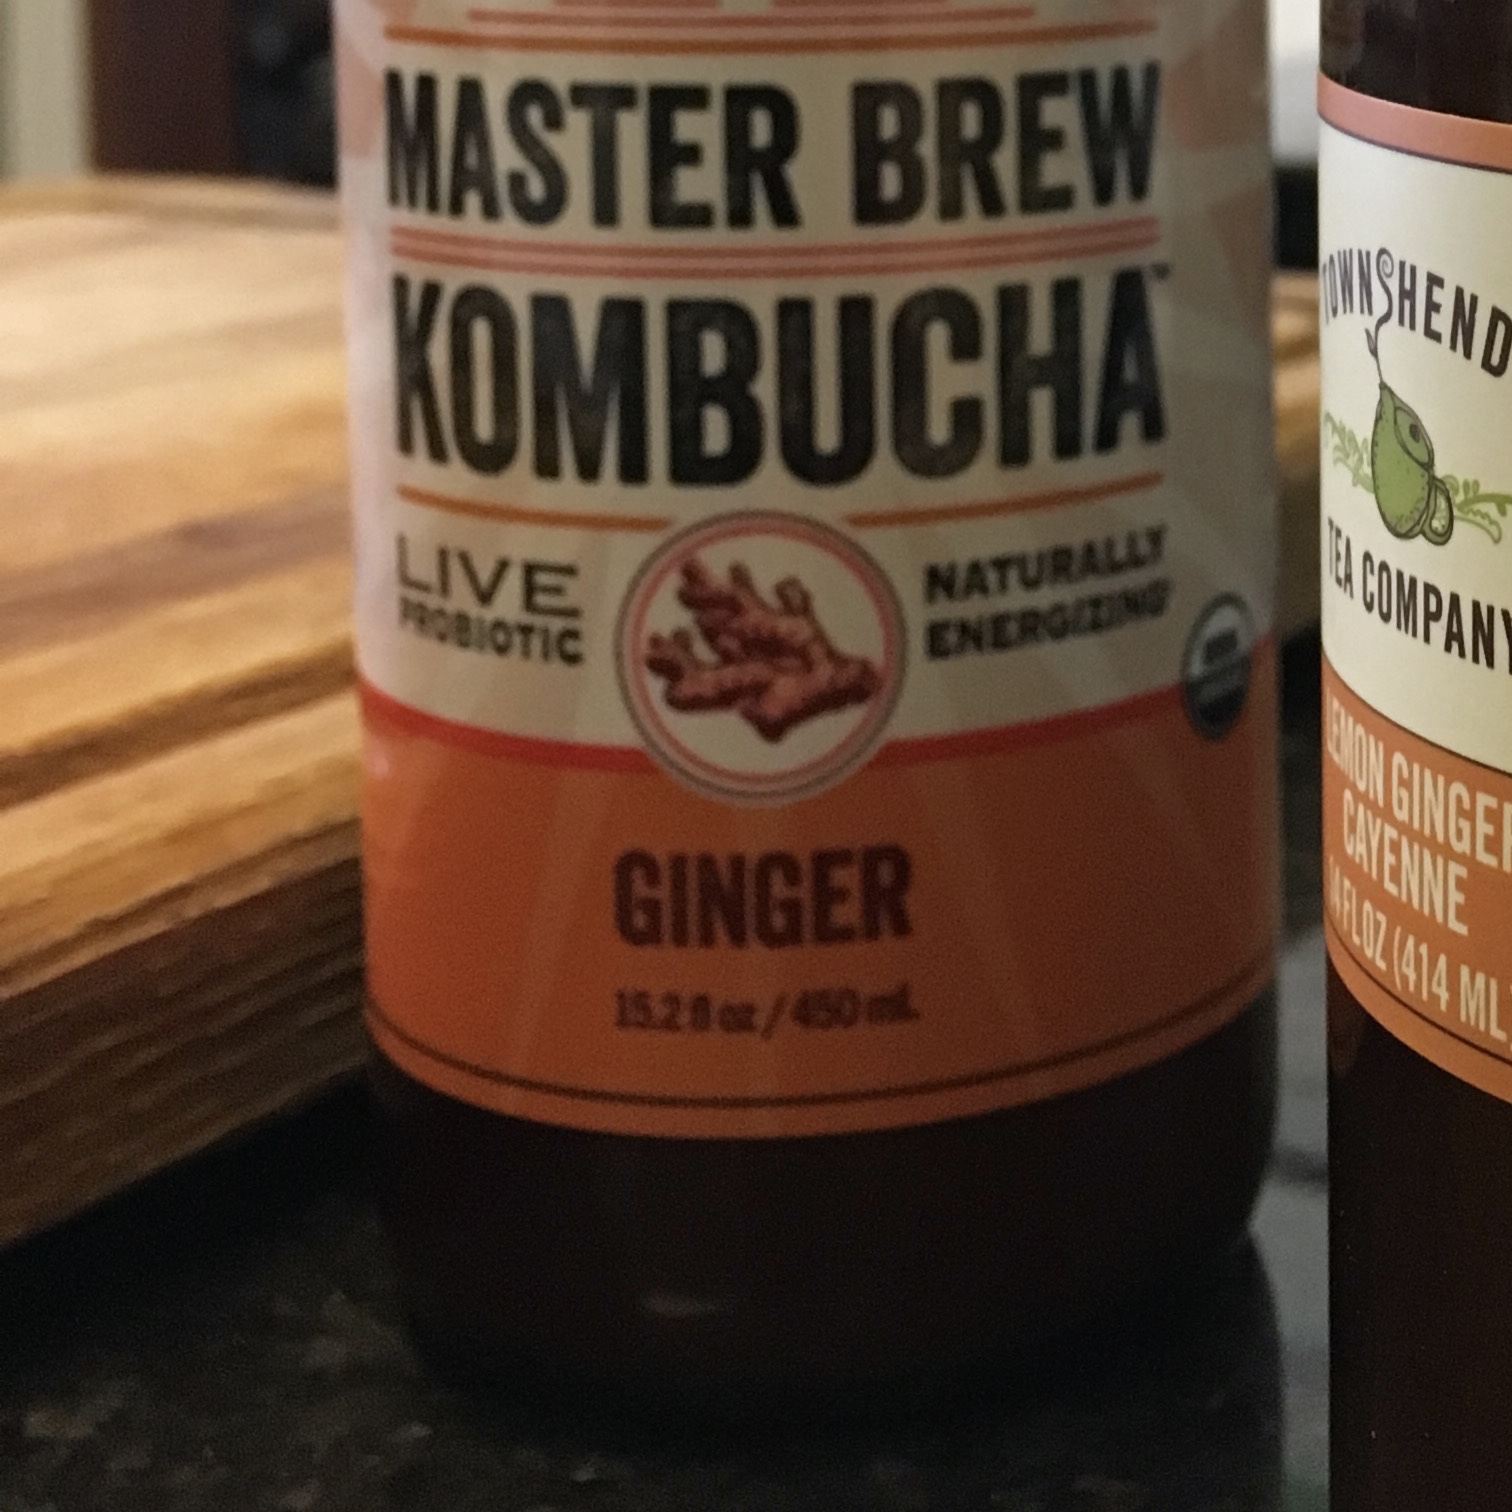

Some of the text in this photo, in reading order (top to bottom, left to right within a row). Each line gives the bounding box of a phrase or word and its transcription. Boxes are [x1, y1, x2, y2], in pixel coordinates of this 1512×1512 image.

[384, 59, 1161, 232] MASTER BREW
[395, 532, 582, 619] LIVE
[923, 521, 1167, 604] NATURALLY
[1327, 517, 1354, 601] TEA
[398, 595, 585, 667] PROBIOTIC
[926, 575, 1172, 661] ENERGIZING
[613, 840, 913, 950] GINGER
[1342, 788, 1469, 937] CAYENNE
[1392, 924, 1451, 1014] (414
